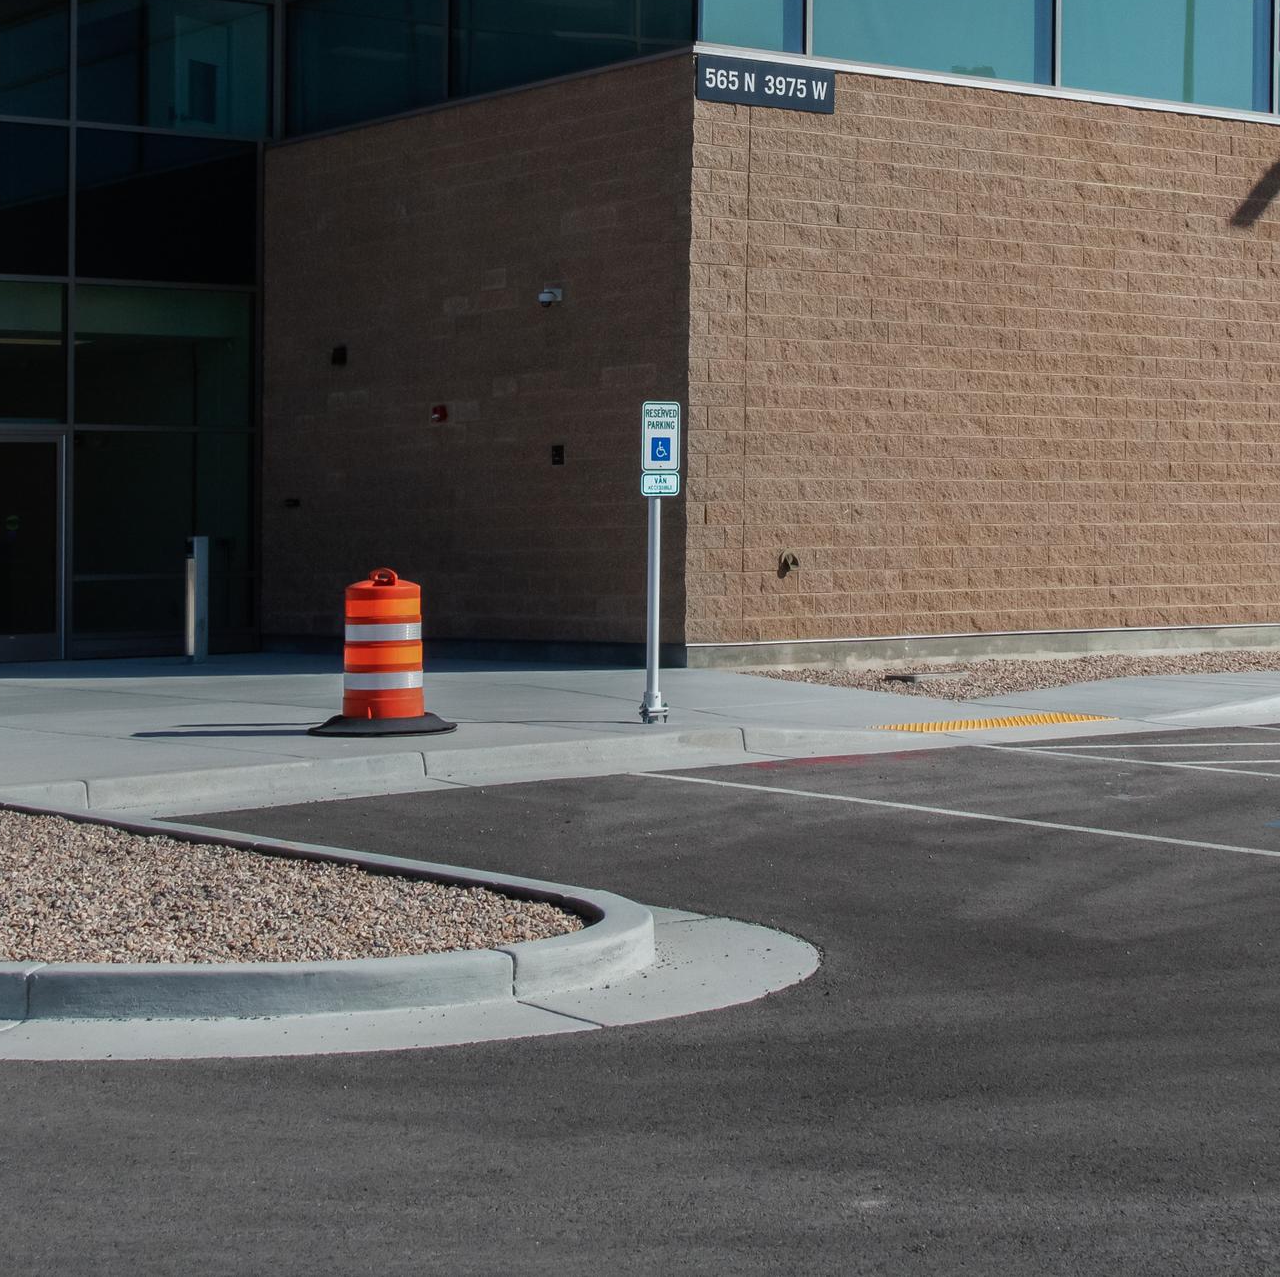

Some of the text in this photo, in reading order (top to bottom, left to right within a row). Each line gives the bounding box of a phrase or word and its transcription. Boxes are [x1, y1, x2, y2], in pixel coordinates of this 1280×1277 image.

[705, 68, 827, 100] 565 N 3975 W
[645, 408, 677, 418] RESERVED
[647, 420, 675, 430] PARKING
